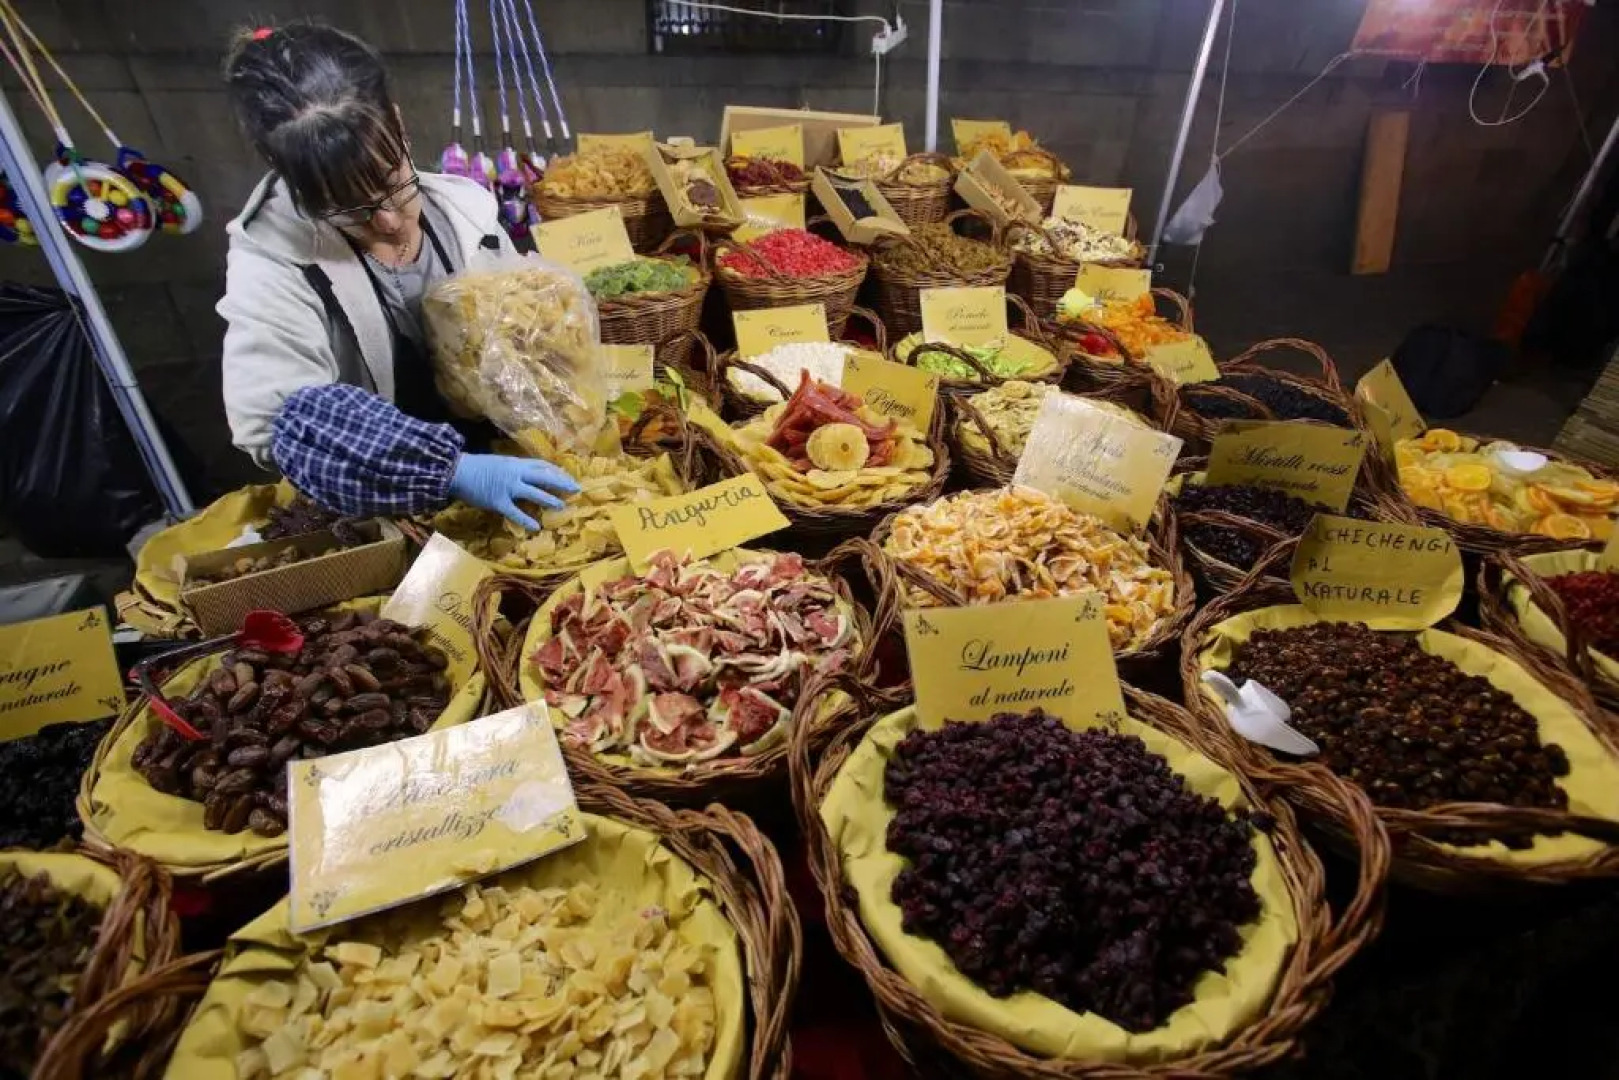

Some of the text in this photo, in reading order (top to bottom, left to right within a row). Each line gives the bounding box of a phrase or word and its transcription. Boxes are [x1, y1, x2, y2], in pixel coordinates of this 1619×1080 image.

[637, 485, 761, 531] Anguria
[1326, 528, 1451, 554] CHECHENGI
[1302, 581, 1423, 605] NATURALE
[958, 638, 1071, 677] Lamponi
[0, 659, 71, 690] rugne
[969, 678, 1076, 707] al naturale
